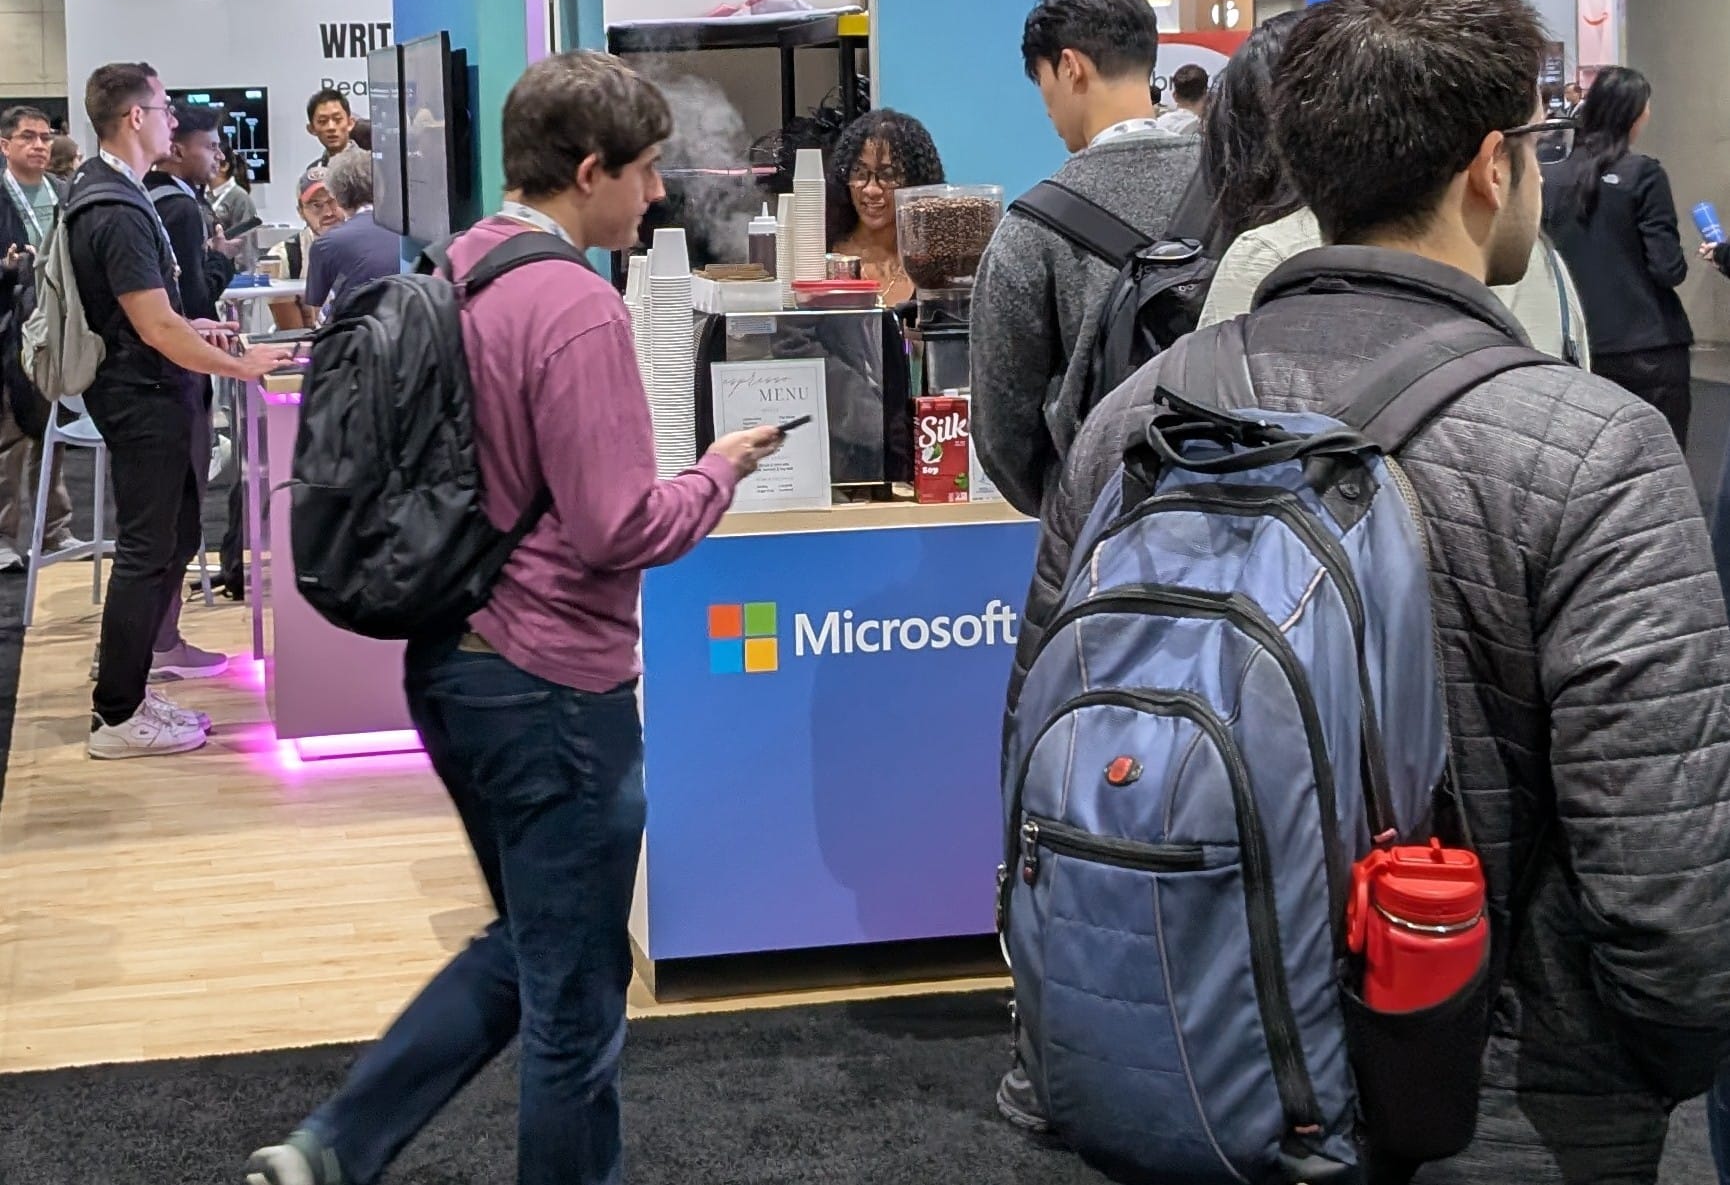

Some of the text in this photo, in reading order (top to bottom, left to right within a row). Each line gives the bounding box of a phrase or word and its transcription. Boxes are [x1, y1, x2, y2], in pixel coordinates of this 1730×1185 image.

[759, 387, 809, 402] MENU
[919, 412, 969, 448] Silk
[794, 599, 1017, 656] Microsoft
